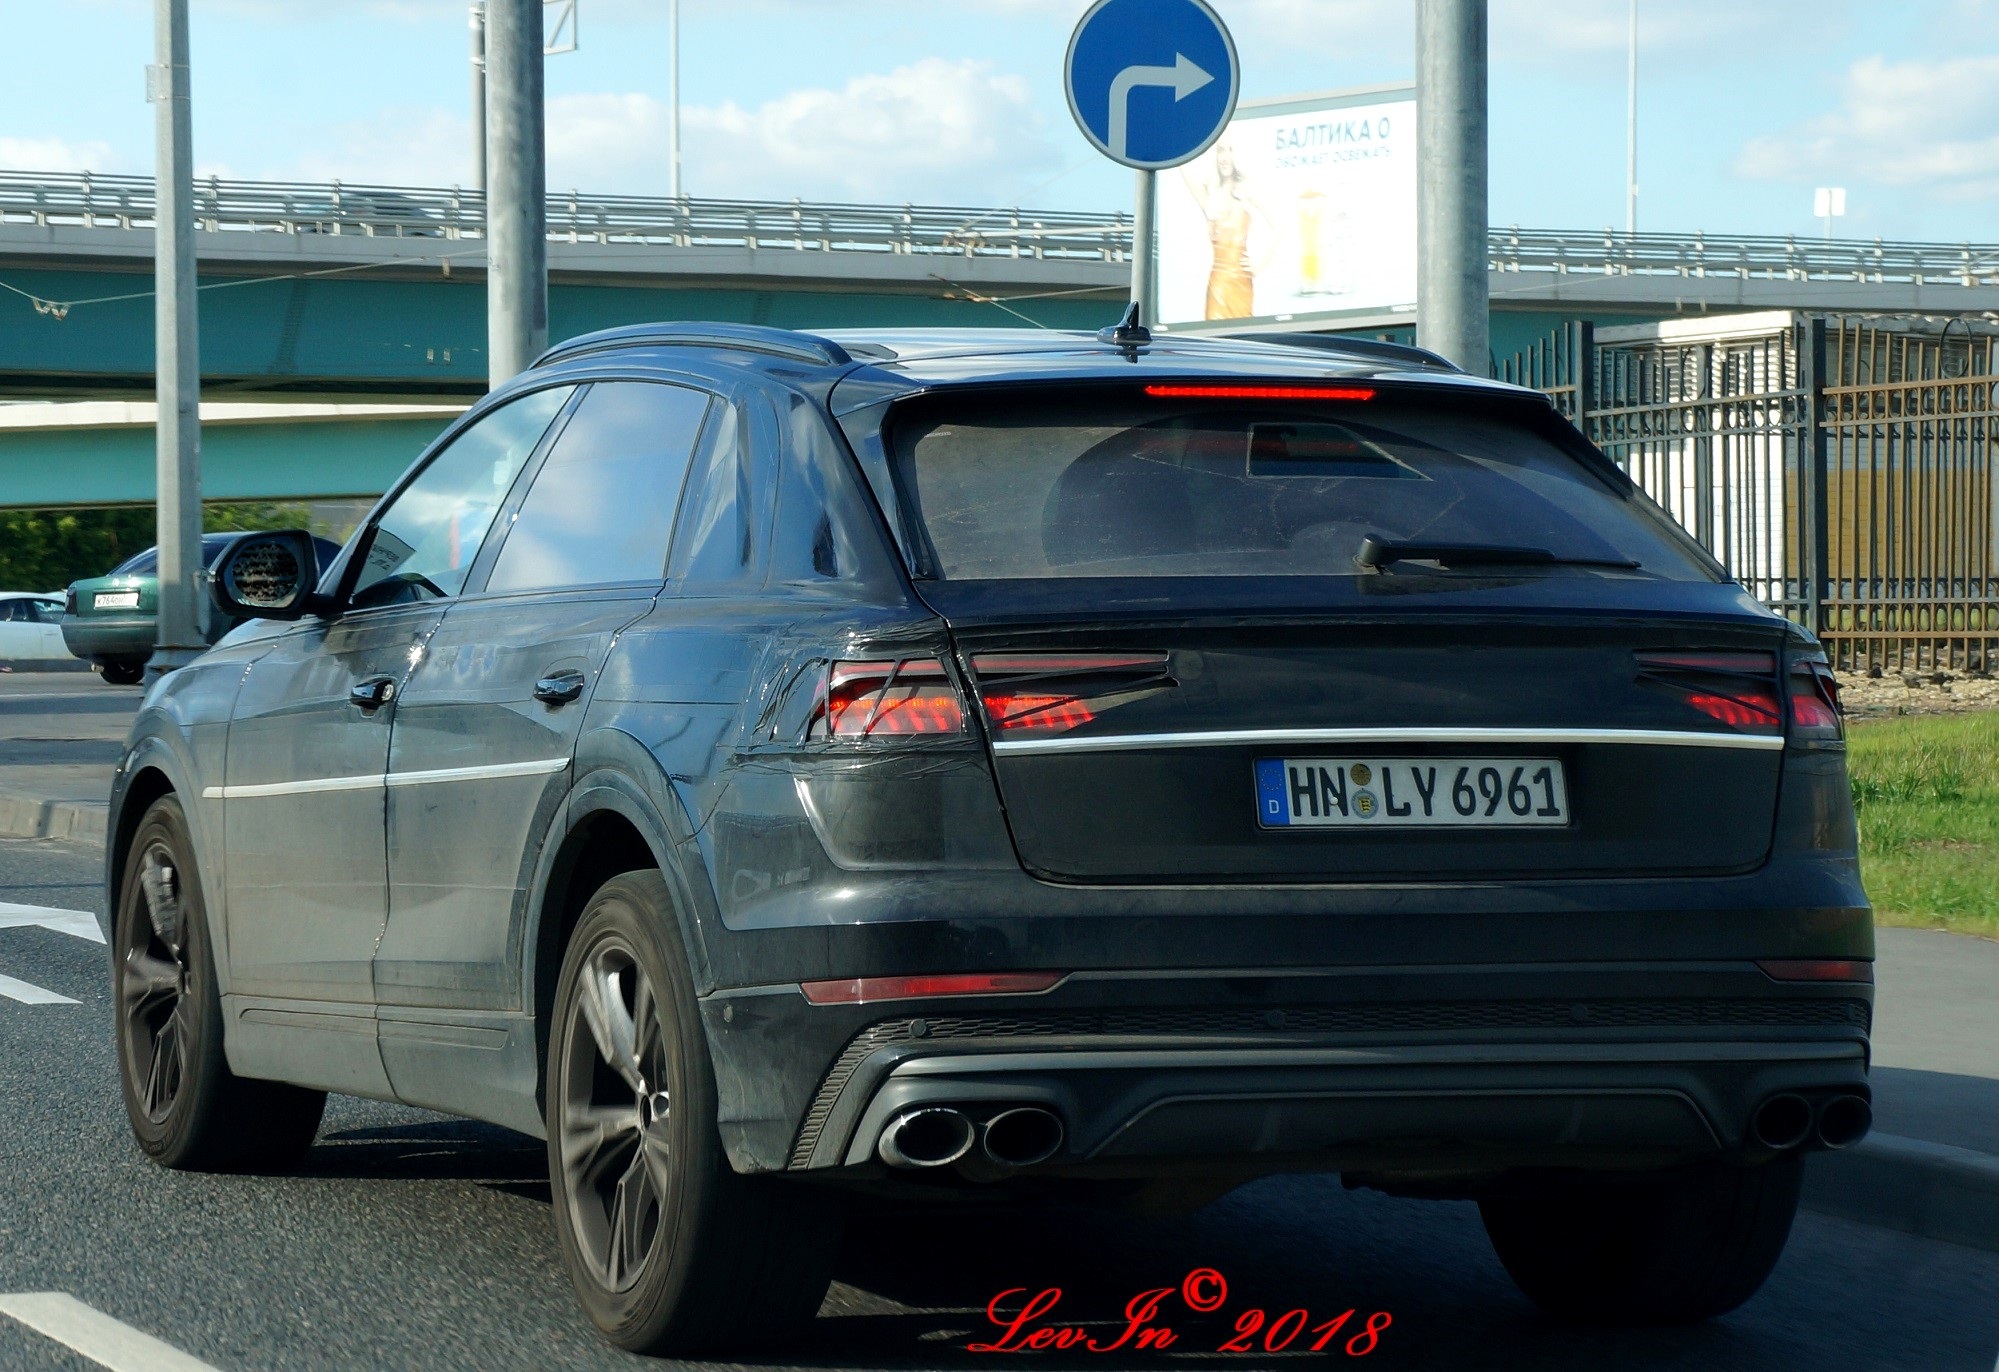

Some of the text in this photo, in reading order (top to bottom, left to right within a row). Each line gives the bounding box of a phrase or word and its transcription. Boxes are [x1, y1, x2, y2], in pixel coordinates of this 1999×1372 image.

[1276, 119, 1371, 150] БАЛТИКА
[1268, 799, 1280, 814] D
[1289, 767, 1349, 817] HN
[1382, 767, 1436, 817] LY
[1452, 767, 1560, 817] 6961
